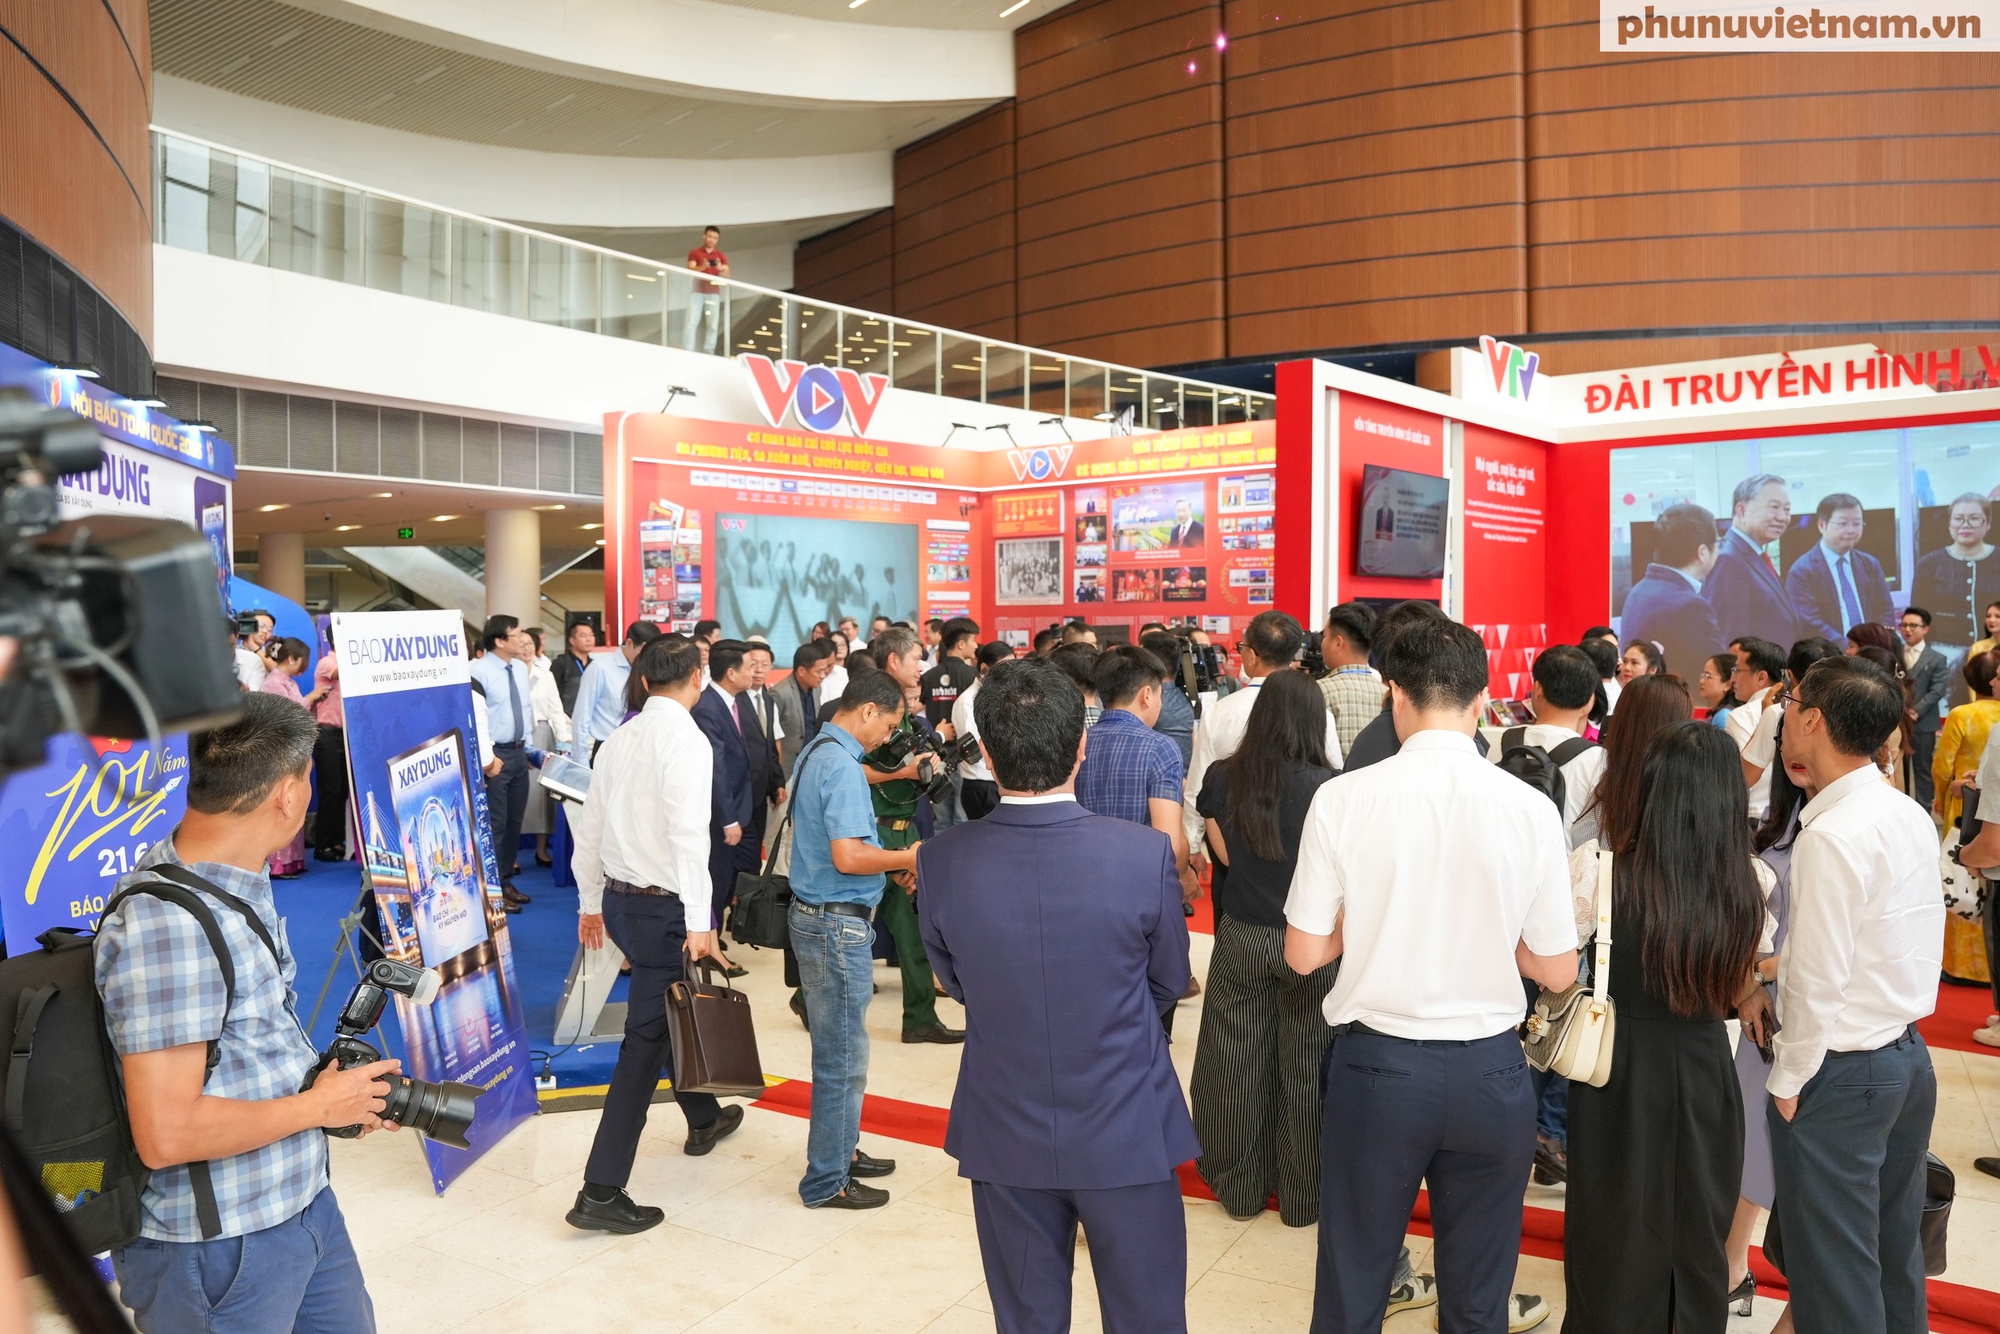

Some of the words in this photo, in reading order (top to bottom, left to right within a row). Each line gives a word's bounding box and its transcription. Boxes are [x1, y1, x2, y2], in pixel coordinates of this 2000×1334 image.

[1483, 337, 1538, 402] VTV
[1584, 373, 1651, 414] ĐÀI
[1662, 352, 1832, 405] TRUYỀN
[1845, 348, 1961, 392] HÌNH
[741, 354, 889, 438] VOV
[70, 390, 92, 419] HỘI
[94, 401, 119, 429] BÁO
[151, 425, 178, 450] QUỐC
[1007, 444, 1074, 482] VOV
[721, 518, 747, 533] VOV
[371, 667, 448, 683] www.baoxaydung.vn
[148, 746, 188, 780] Năm
[70, 894, 104, 918] BÁO
